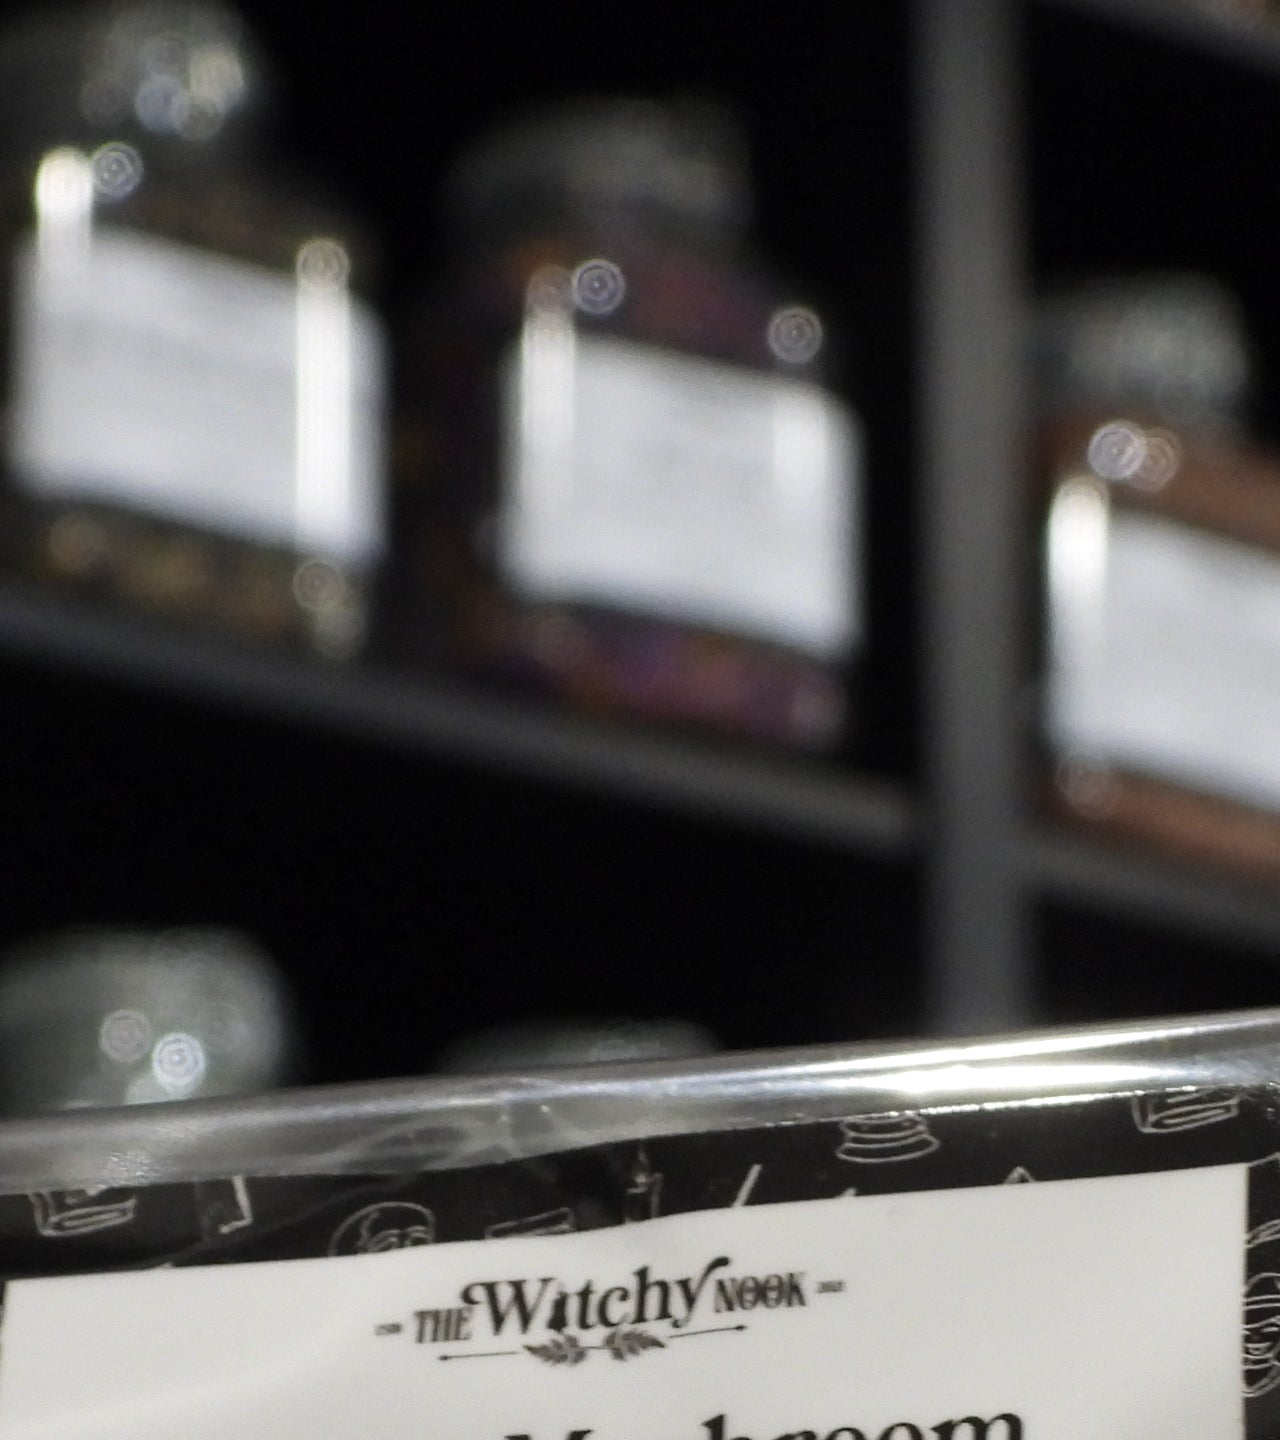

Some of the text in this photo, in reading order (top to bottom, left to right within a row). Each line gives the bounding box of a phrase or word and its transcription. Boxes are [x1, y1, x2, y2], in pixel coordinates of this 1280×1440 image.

[414, 1256, 806, 1344] THE Witchy NOOK
